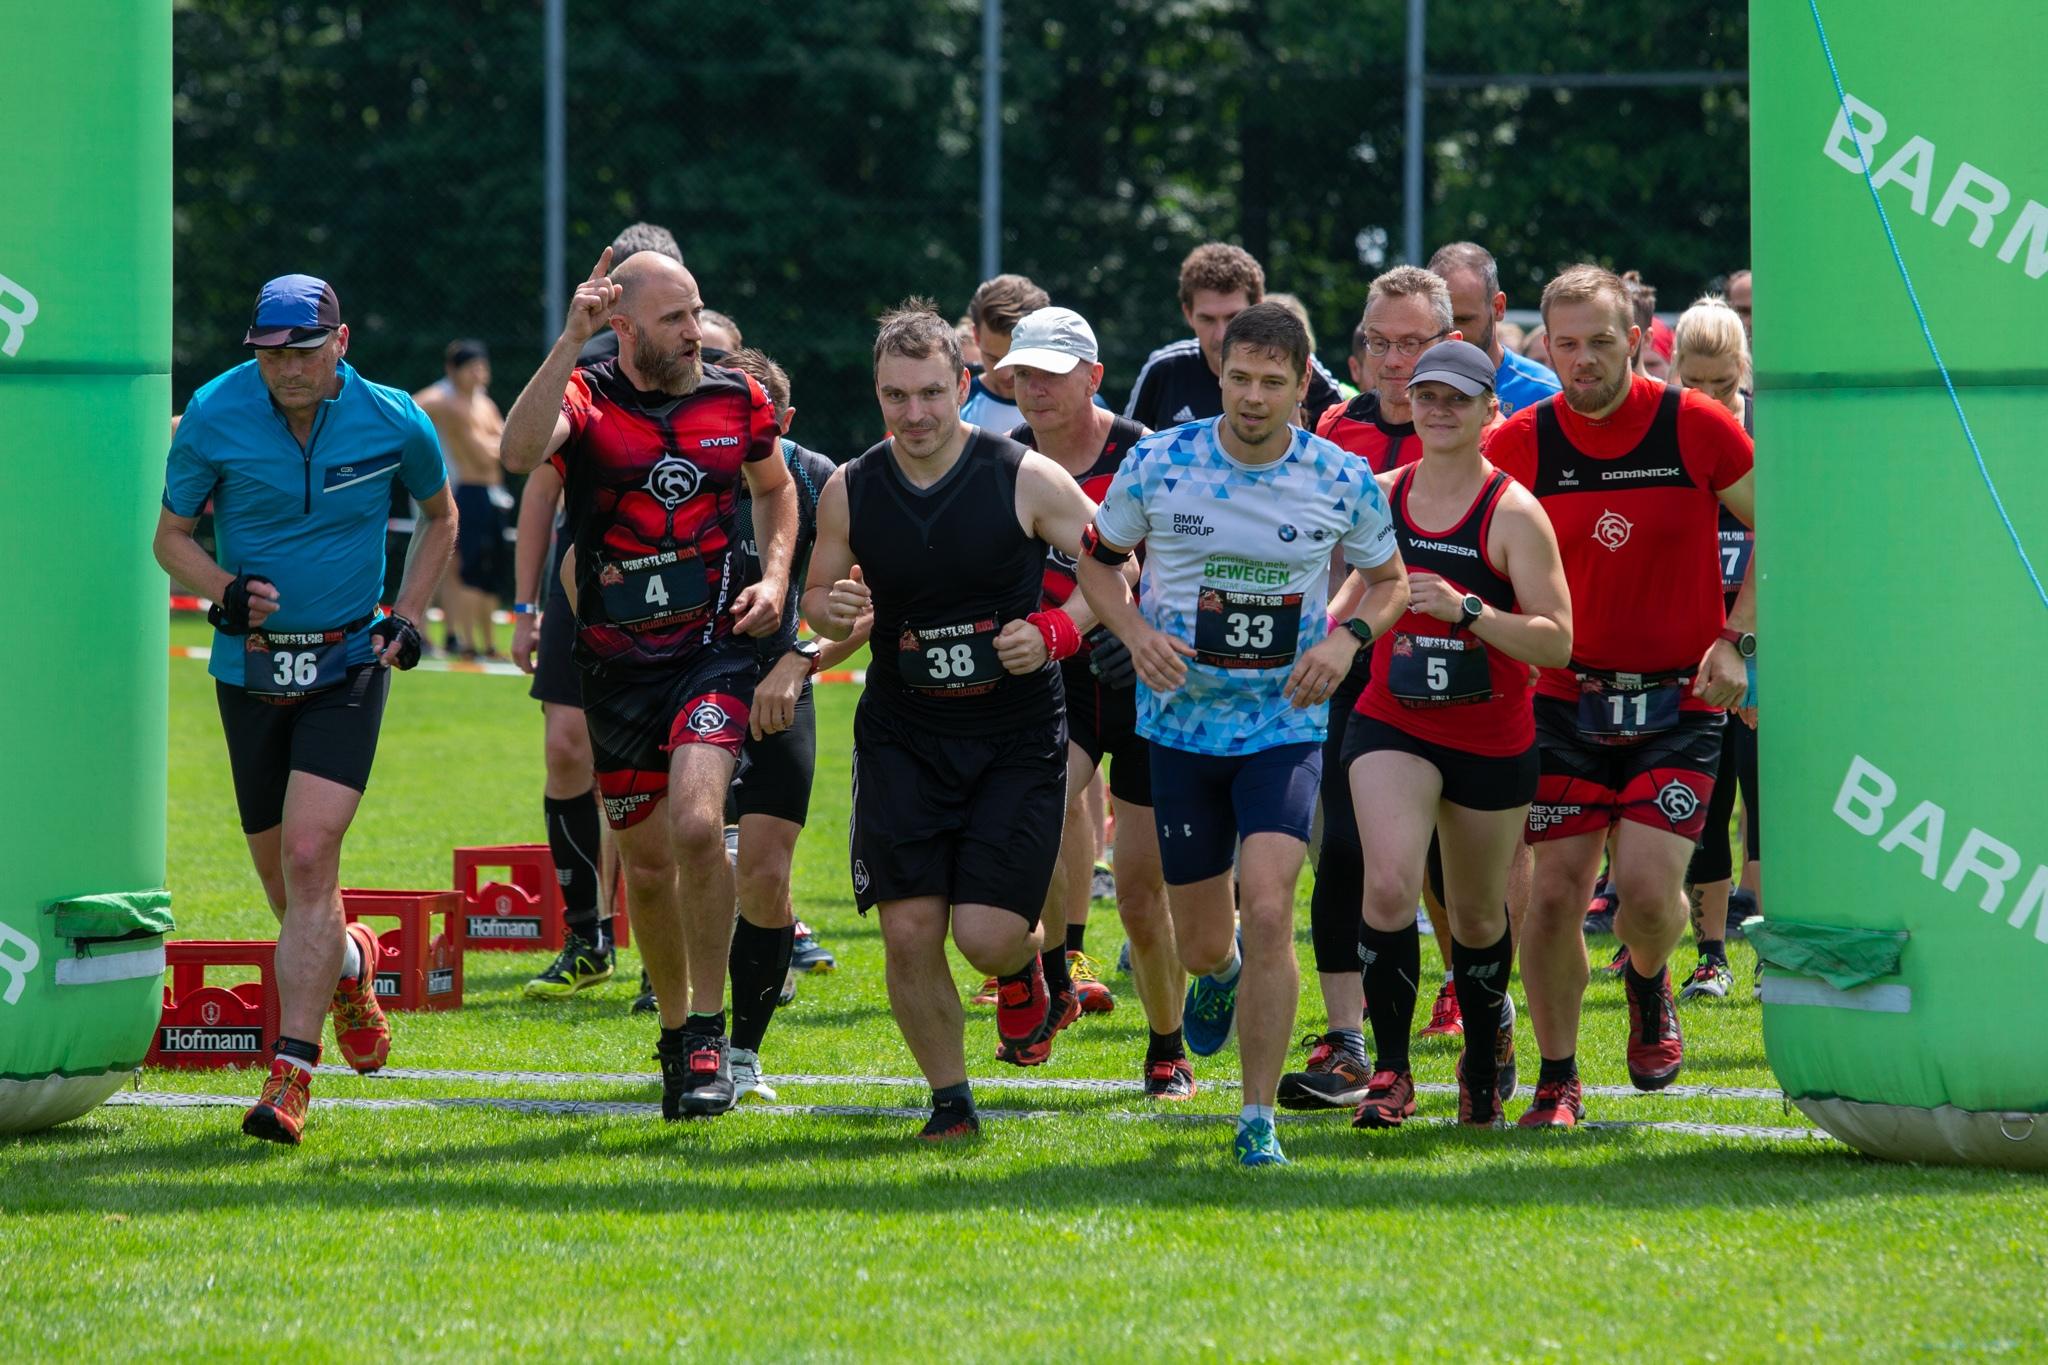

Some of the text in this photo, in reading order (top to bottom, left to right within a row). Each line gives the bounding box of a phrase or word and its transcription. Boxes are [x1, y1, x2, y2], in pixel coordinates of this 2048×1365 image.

[700, 436, 739, 447] SVEN
[1601, 467, 1680, 480] DOMINICK
[1173, 513, 1204, 525] BMW
[1173, 524, 1214, 536] GROUP
[1409, 538, 1478, 559] VANESSA
[1203, 562, 1290, 585] BEWEGEN
[645, 574, 670, 606] 4
[1225, 612, 1274, 649] 33
[273, 651, 318, 686] 36
[926, 643, 975, 679] 38
[1427, 657, 1449, 691] 5
[1608, 693, 1647, 725] 11
[1529, 805, 1581, 815] NEVER
[1529, 814, 1562, 824] GIVE
[1529, 823, 1547, 832] UP
[469, 917, 538, 937] Hofmann
[165, 1029, 257, 1049] Hofmann
